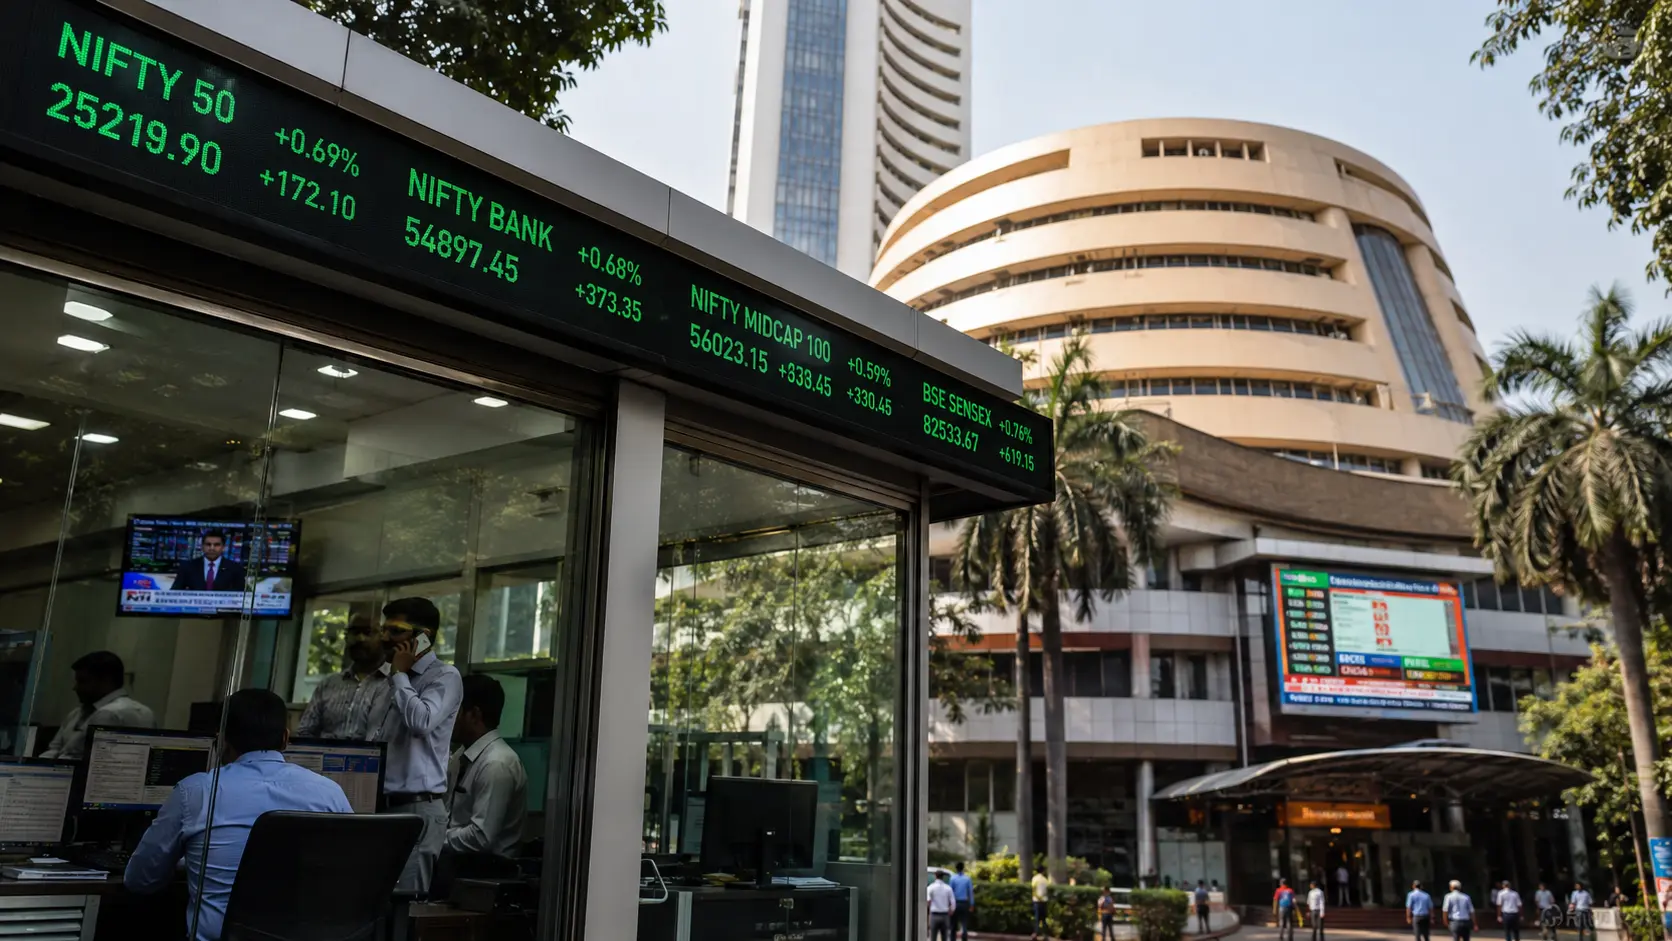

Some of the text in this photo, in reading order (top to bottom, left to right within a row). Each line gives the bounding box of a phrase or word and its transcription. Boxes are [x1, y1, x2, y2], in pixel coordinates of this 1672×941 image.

[58, 22, 235, 124] NIFTY 50
[47, 83, 221, 175] 25219.90
[274, 127, 360, 177] +0.69%
[259, 169, 355, 221] +172.10
[408, 168, 553, 252] NIFTY BANK
[405, 216, 519, 283] 54897.45
[578, 246, 642, 286] +0.68%
[575, 284, 642, 323] +373.35
[690, 284, 831, 363] NIFTY MIDCAP 100
[690, 323, 768, 374] 56023.15
[847, 357, 892, 388] +0.59%
[846, 387, 892, 416] +330.45
[923, 381, 993, 428] BSE SENSEX
[923, 414, 979, 452] 82533.67
[999, 419, 1033, 445] +0.76%
[999, 447, 1035, 472] +619.15
